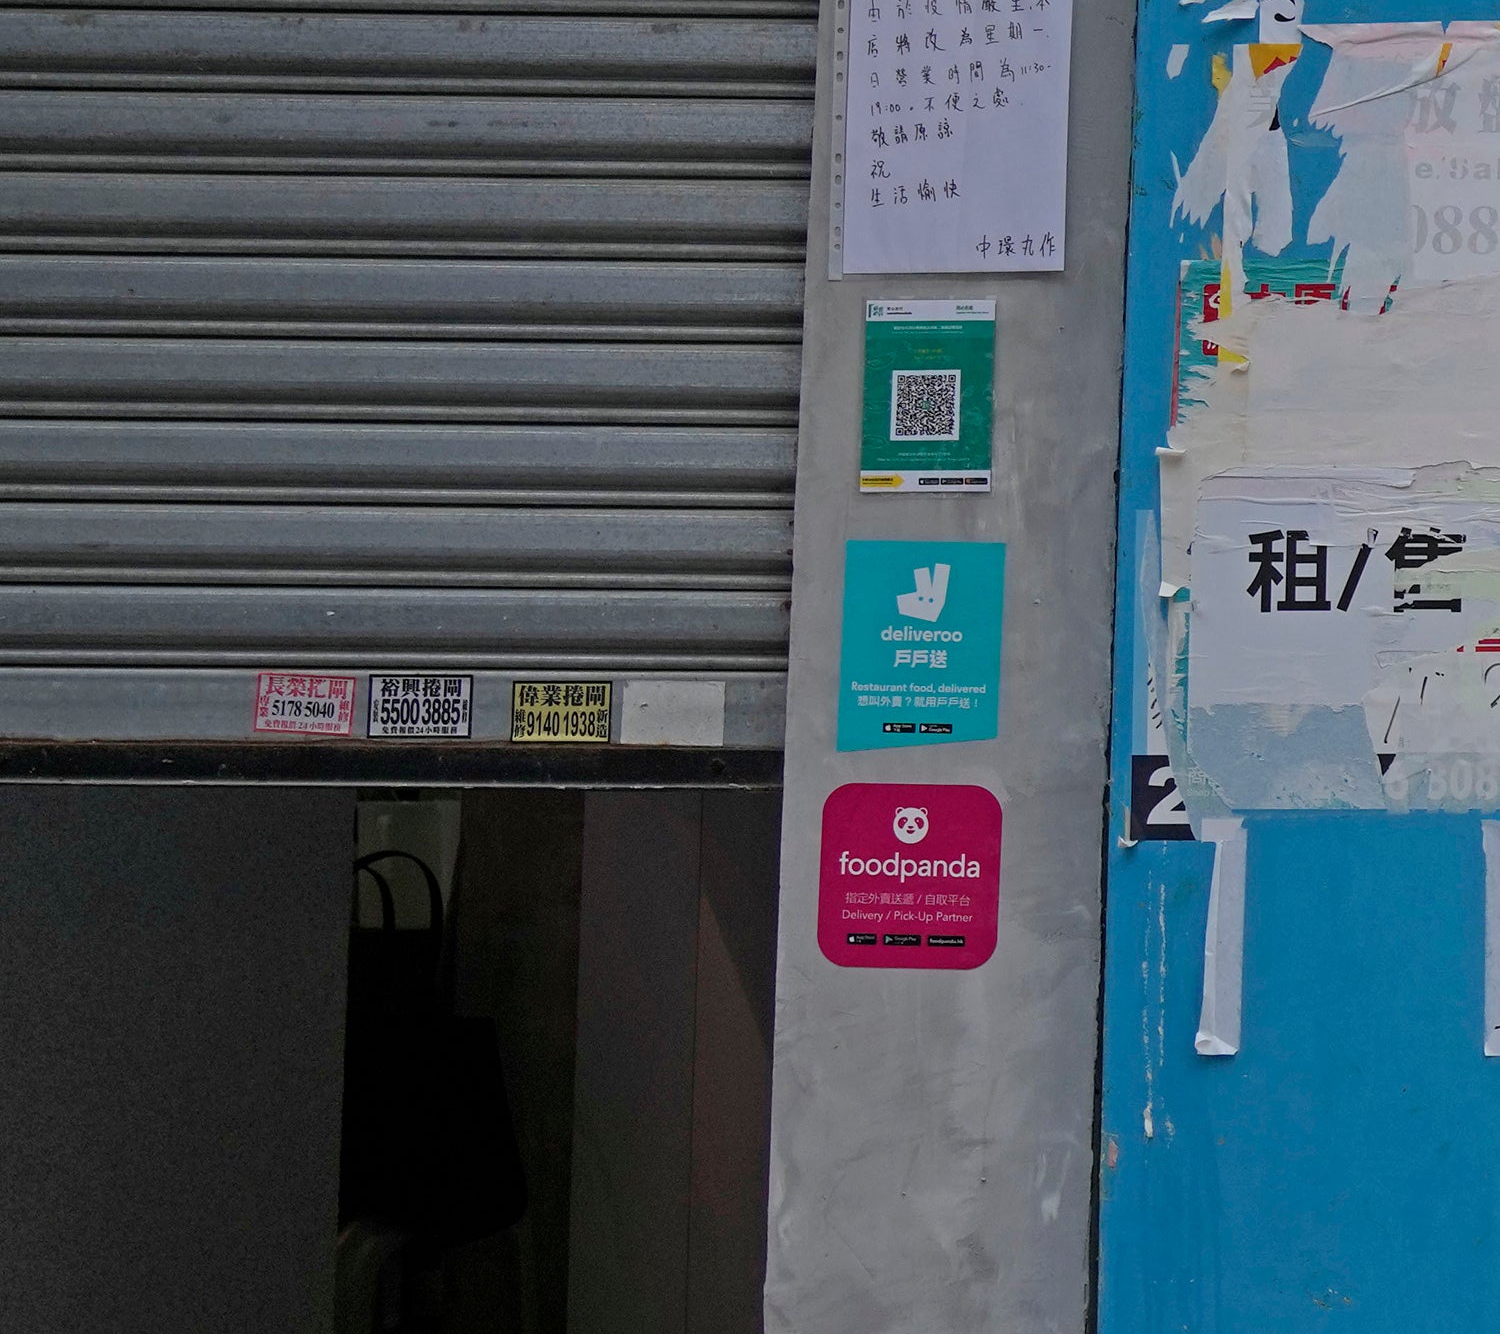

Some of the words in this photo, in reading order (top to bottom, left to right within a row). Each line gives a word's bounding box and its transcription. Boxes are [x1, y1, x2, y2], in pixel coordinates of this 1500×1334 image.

[880, 625, 964, 643] deliveroo
[893, 649, 948, 670] 戶戶送
[519, 684, 607, 707] 偉業捲閘
[851, 681, 907, 693] Restaurant
[909, 681, 936, 694] food,
[938, 683, 987, 694] delivered
[271, 699, 302, 717] 5178
[304, 702, 335, 719] 5040
[380, 698, 419, 726] 5500
[421, 698, 461, 726] 3885
[526, 711, 560, 737] 9140
[563, 711, 596, 737] 1938
[839, 851, 981, 883] foodpanda
[841, 909, 884, 923] Delivery
[893, 910, 934, 923] Pick-Up
[936, 912, 973, 923] Partner
